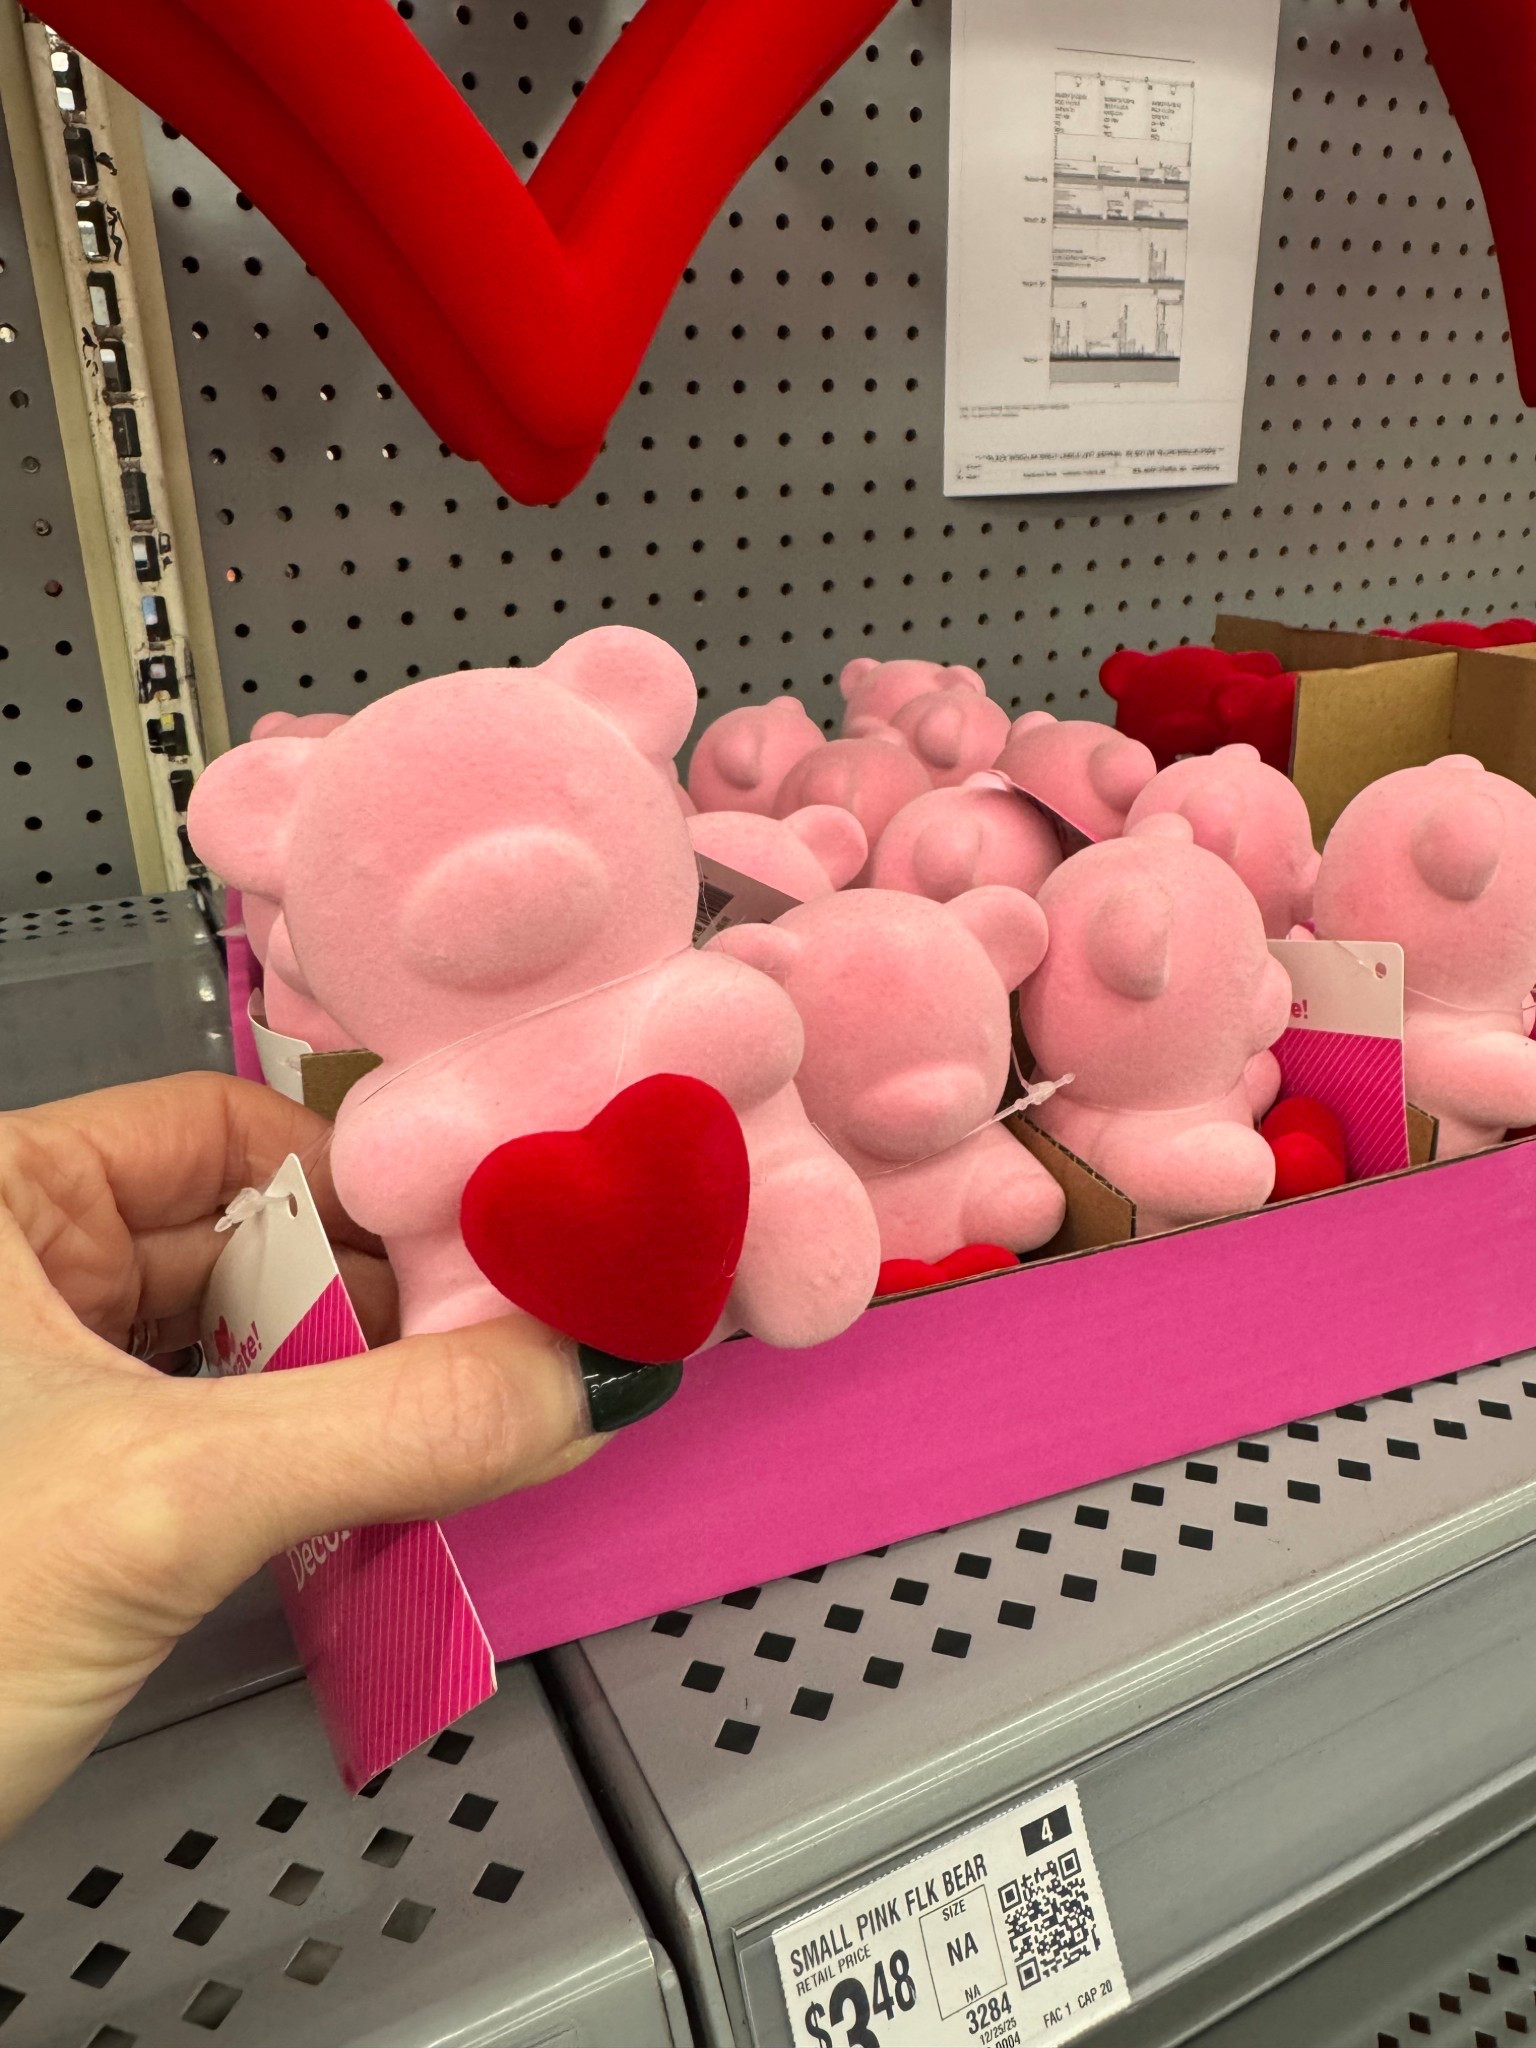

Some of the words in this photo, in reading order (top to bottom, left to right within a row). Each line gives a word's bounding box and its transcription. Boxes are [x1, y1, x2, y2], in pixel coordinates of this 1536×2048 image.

[1041, 1817, 1054, 1842] 4
[790, 1923, 853, 1977] SMALL
[856, 1897, 902, 1941] PINK
[904, 1878, 940, 1916] FLK
[942, 1853, 988, 1897] BEAR
[942, 1898, 967, 1922] SIZE
[946, 1931, 979, 1967] NA
[796, 1965, 836, 1997] RETAIL
[837, 1943, 872, 1973] PRICE
[964, 1983, 981, 2003] NA
[1043, 2007, 1063, 2029] FAC
[1064, 2002, 1072, 2017] 1
[1077, 1986, 1098, 2010] CAP
[1100, 1979, 1114, 1997] 20
[965, 1990, 1012, 2035] 3284
[980, 2016, 1017, 2046] 12/25/25
